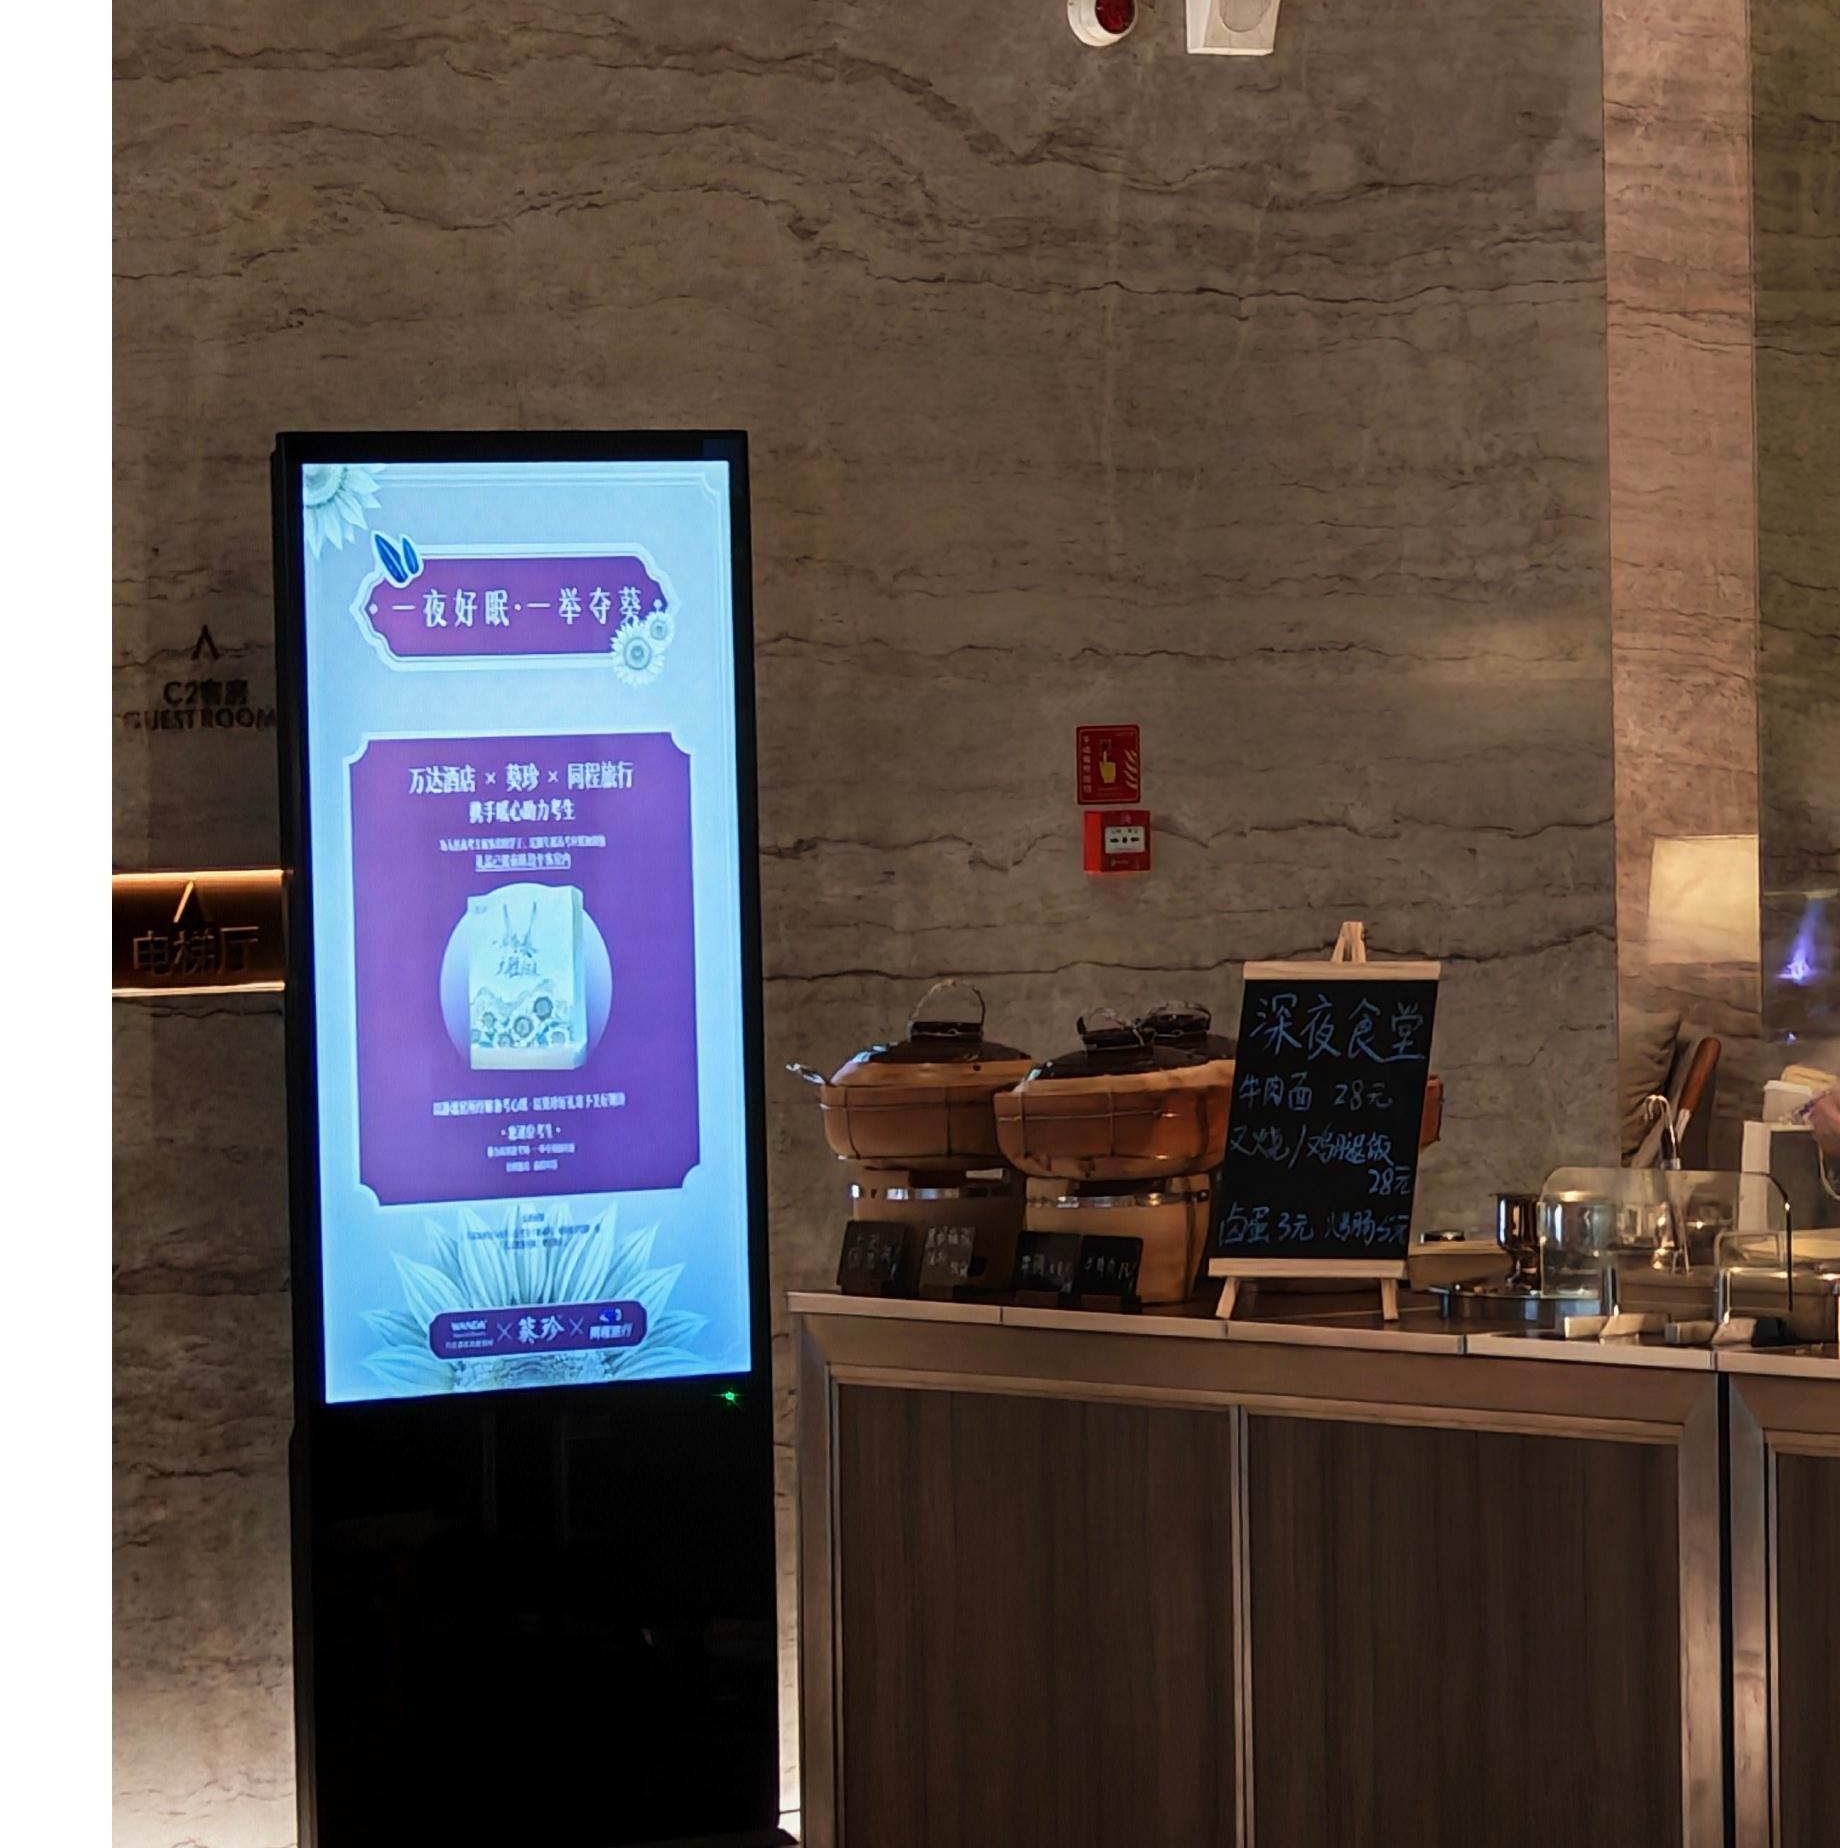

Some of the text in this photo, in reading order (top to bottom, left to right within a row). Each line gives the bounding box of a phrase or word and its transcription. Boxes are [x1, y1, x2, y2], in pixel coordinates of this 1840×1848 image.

[132, 925, 260, 977] 电梯厅
[1249, 993, 1426, 1064] 深夜食堂
[1238, 1071, 1394, 1112] 牛肉面 28元
[1367, 1165, 1411, 1196] 28元
